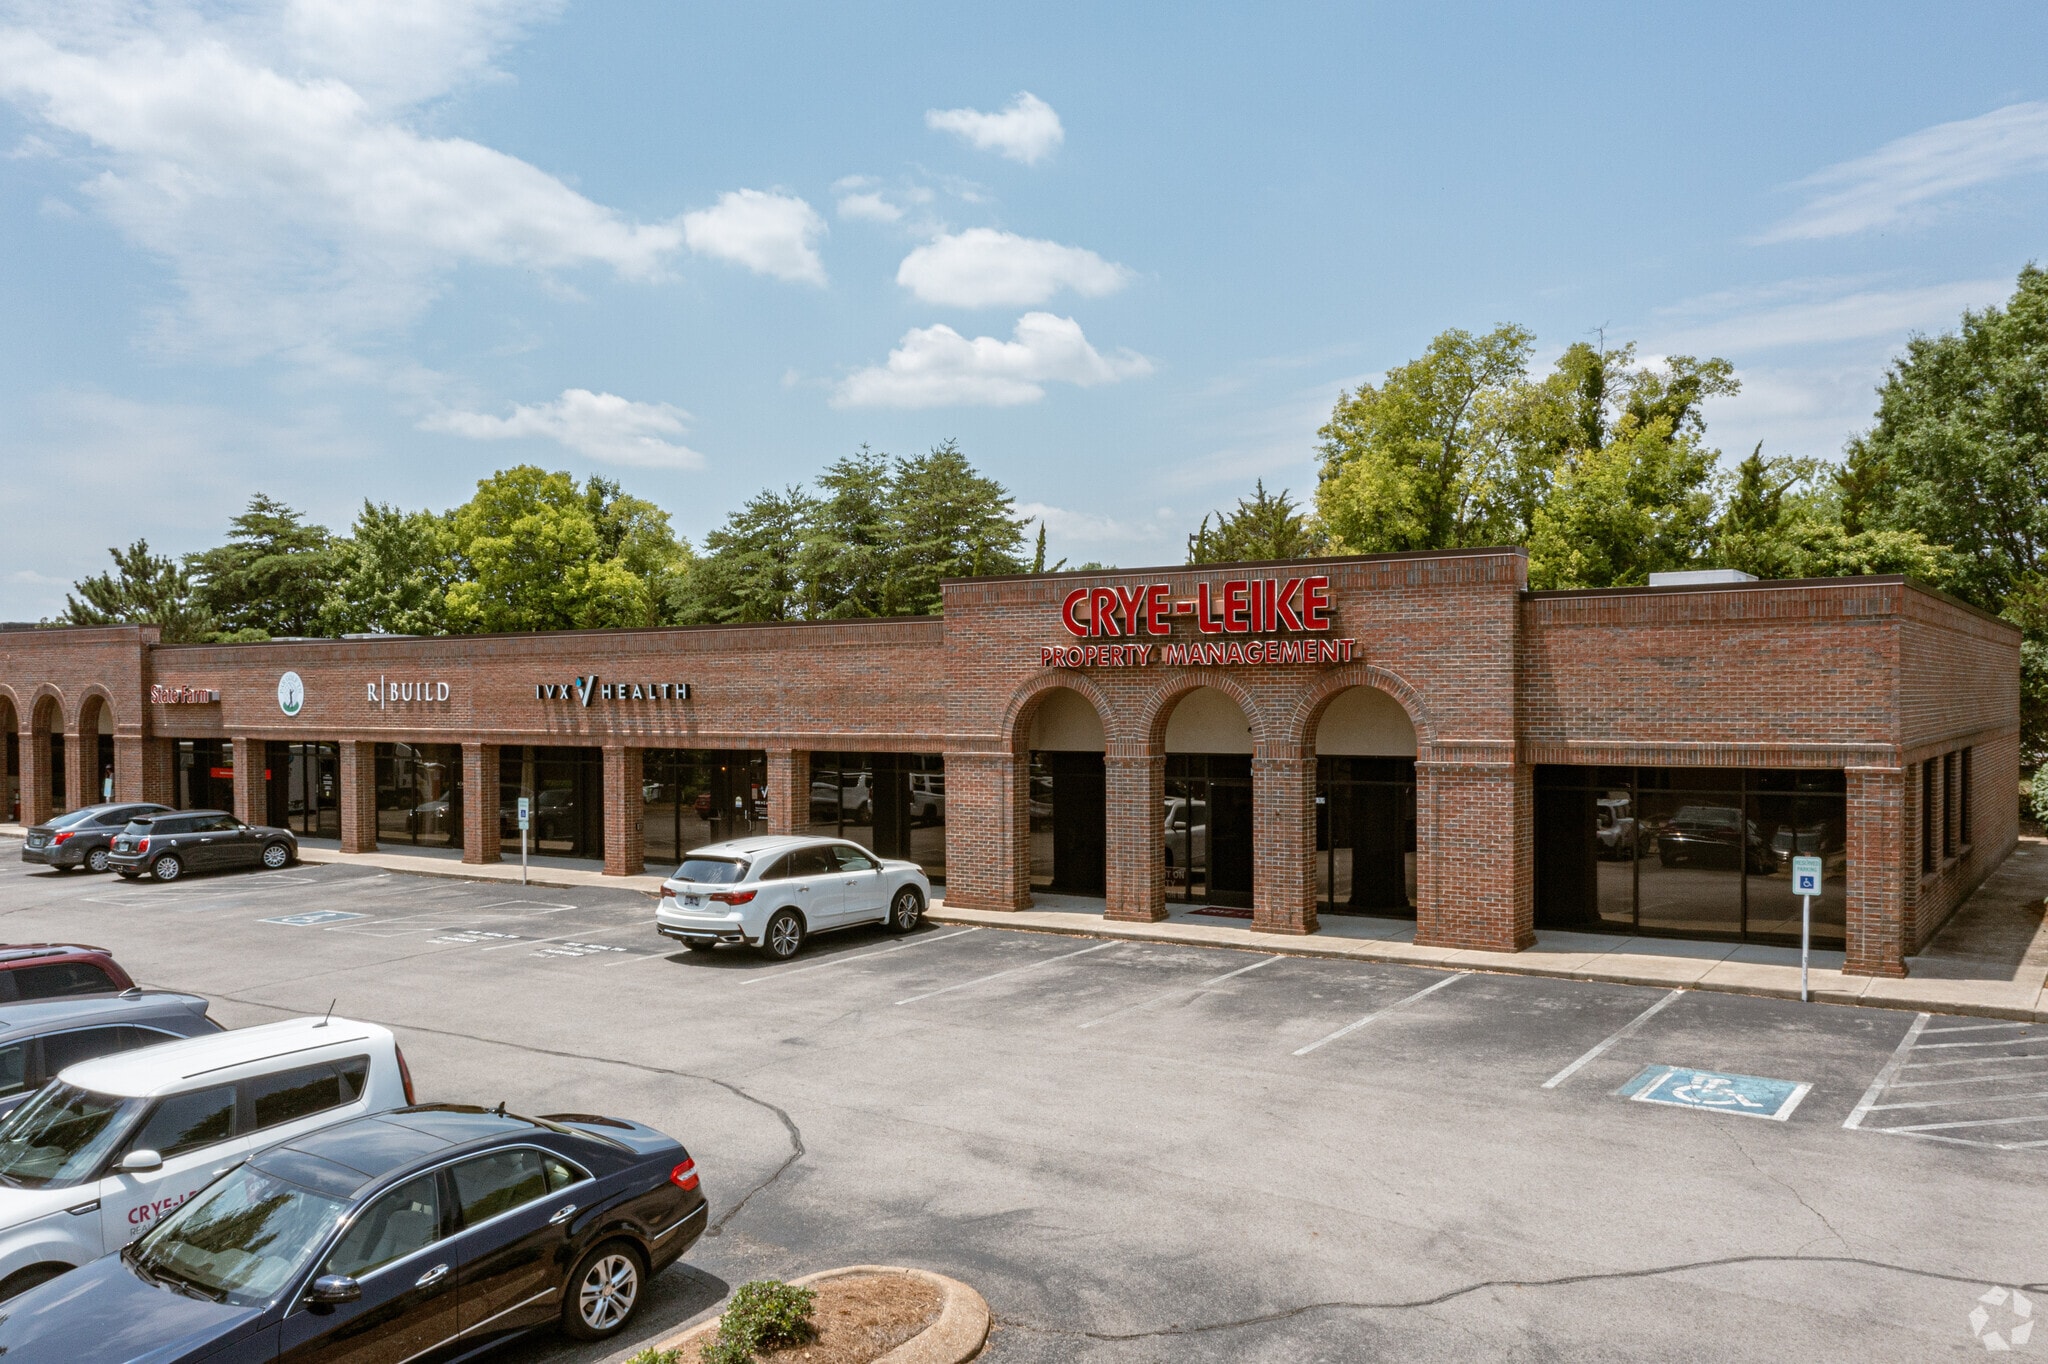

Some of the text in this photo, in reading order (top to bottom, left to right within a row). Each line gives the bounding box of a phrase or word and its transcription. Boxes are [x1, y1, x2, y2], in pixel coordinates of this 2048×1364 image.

[1062, 576, 1331, 638] CRYE-LEIKE
[1041, 638, 1356, 668] PROPERTY MANAGEMENT
[151, 684, 210, 703] State Farm
[535, 683, 688, 700] IVX HEALTH
